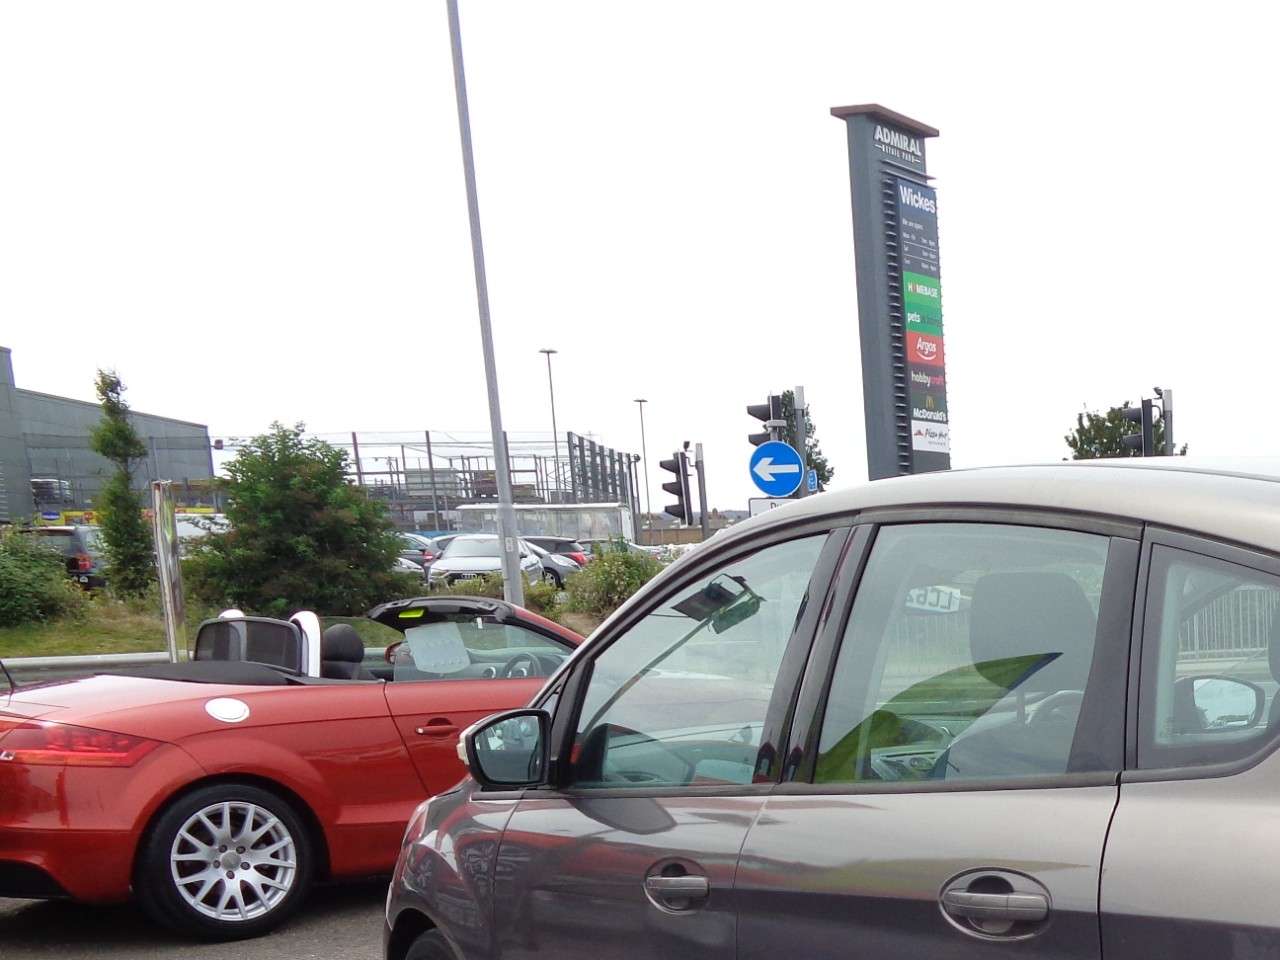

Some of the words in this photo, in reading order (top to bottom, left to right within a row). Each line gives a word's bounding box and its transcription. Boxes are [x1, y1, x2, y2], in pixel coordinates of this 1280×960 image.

[874, 124, 922, 156] ADMIRAL
[899, 184, 936, 214] Wickes
[916, 336, 937, 355] Argos
[913, 407, 947, 422] McDonald's
